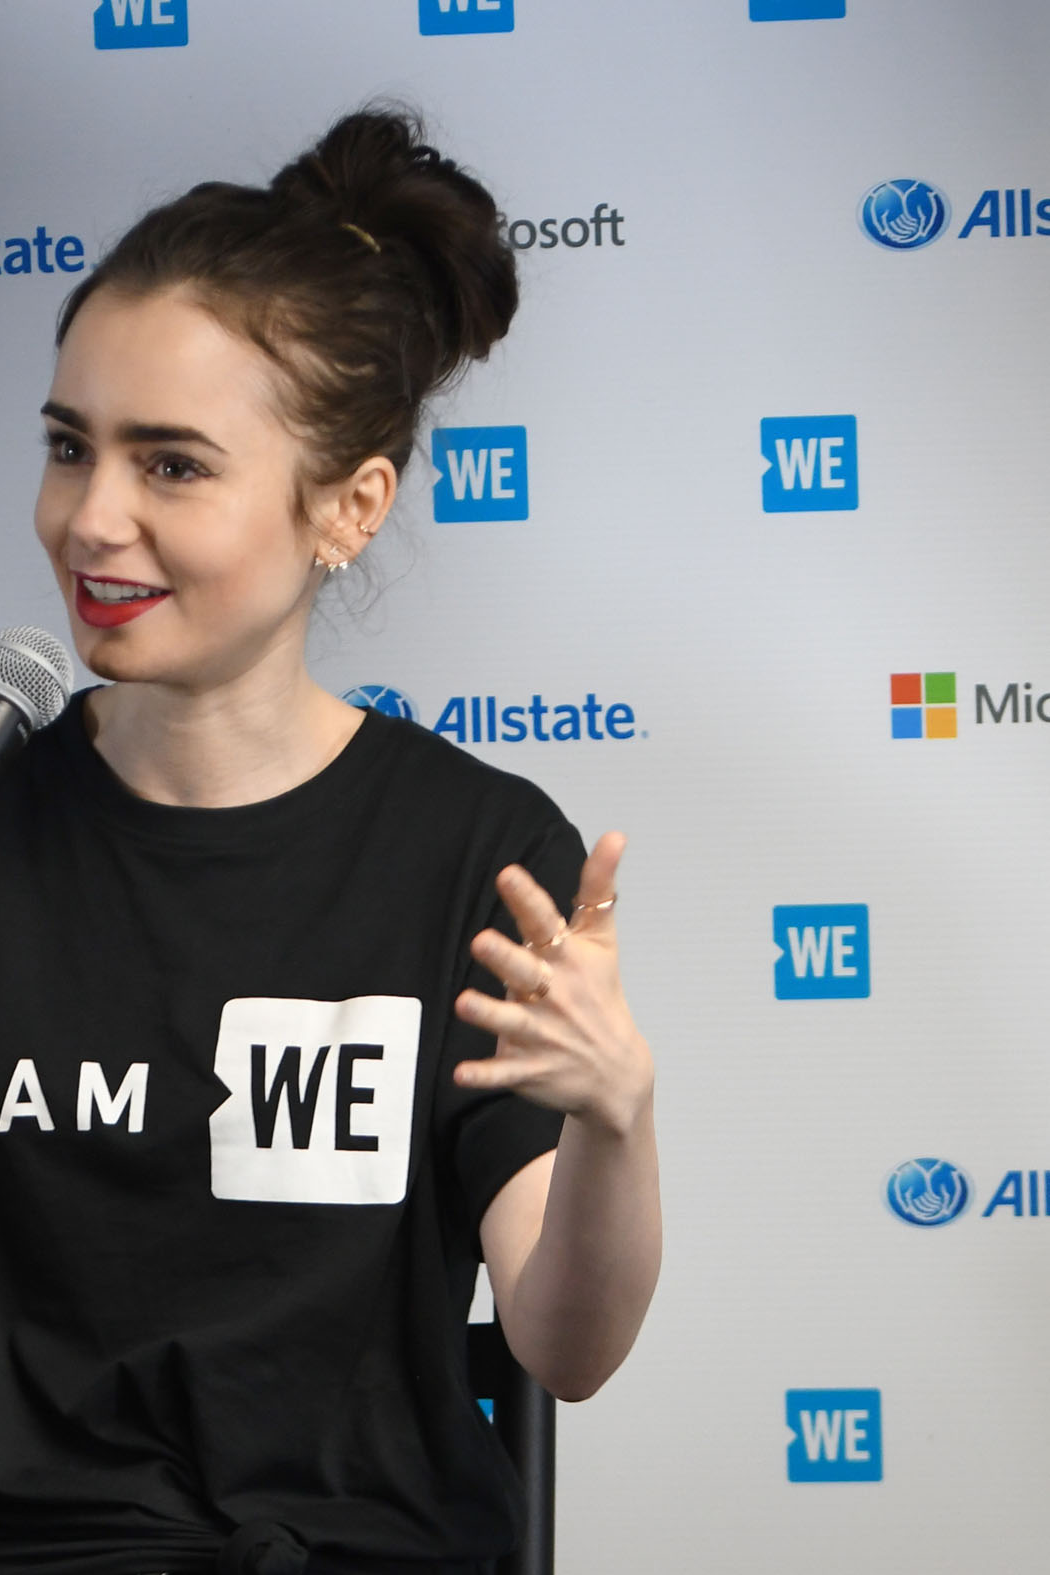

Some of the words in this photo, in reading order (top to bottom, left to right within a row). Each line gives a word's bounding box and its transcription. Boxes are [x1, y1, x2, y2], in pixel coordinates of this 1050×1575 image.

[445, 447, 515, 501] WE
[775, 437, 845, 491] WE
[433, 693, 635, 743] Allstate
[787, 925, 858, 978] WE
[250, 1043, 385, 1152] WE
[800, 1409, 871, 1461] WE
